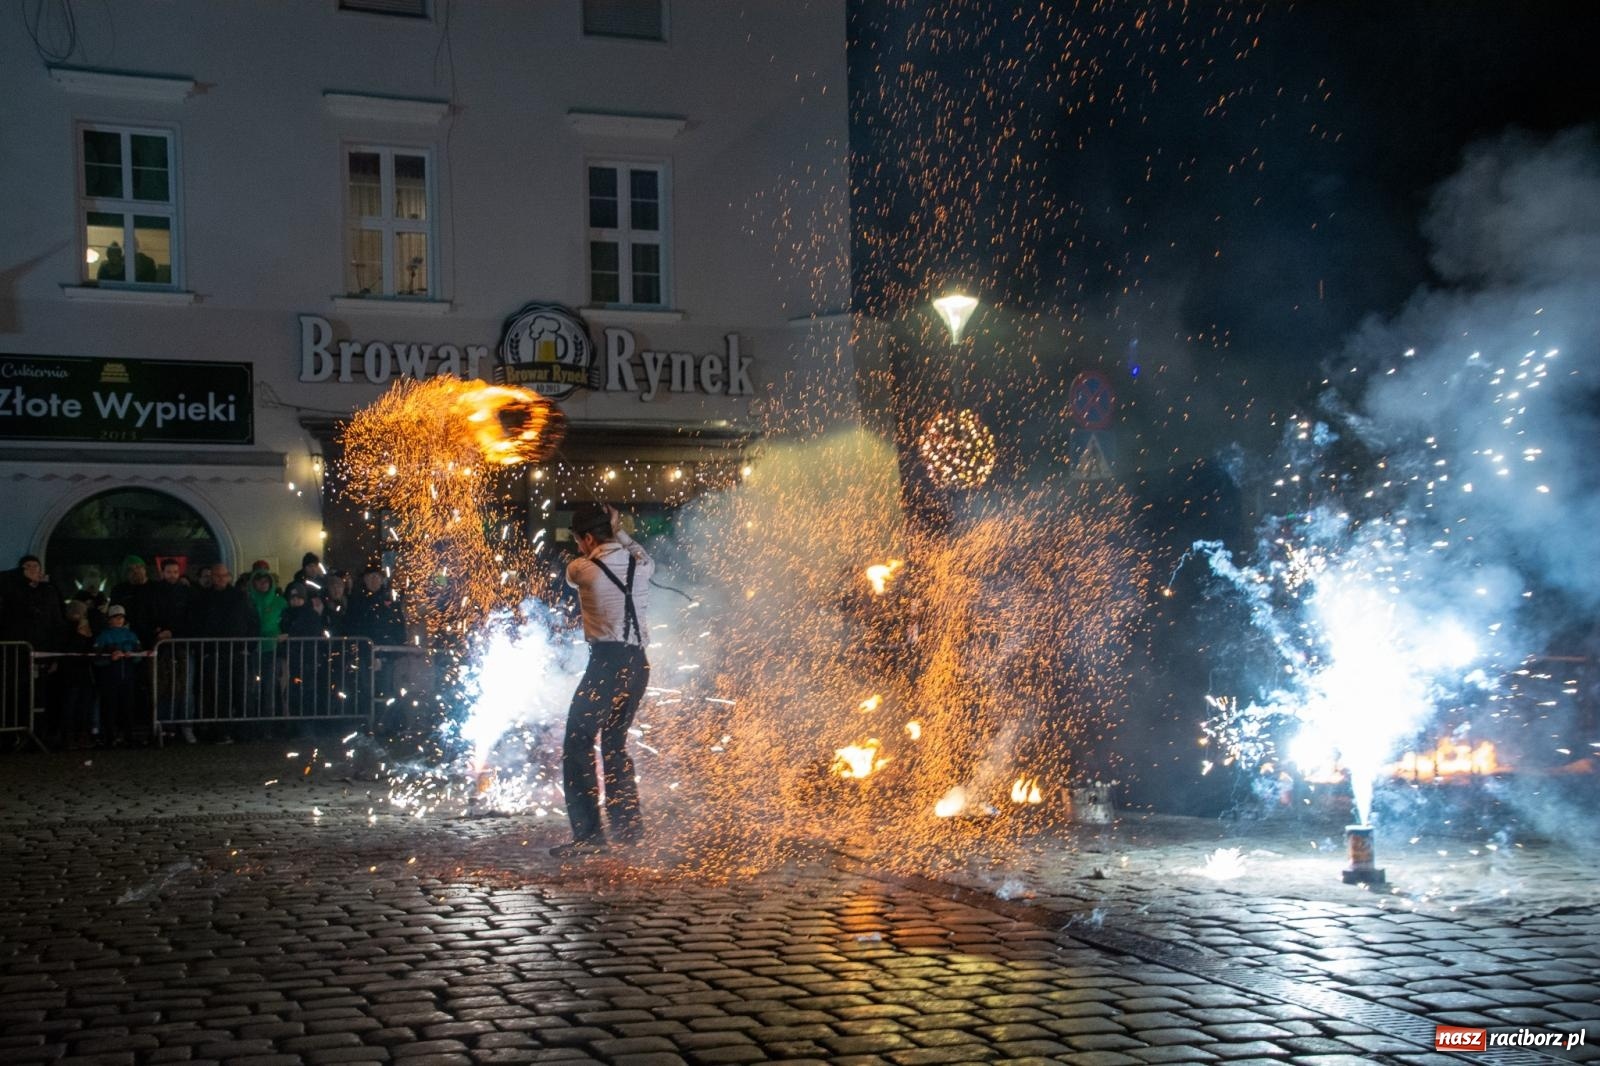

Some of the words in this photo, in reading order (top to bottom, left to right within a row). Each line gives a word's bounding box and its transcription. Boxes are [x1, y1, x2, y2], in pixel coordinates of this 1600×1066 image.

[1, 362, 70, 379] Cukiernia
[299, 315, 488, 385] Browar
[603, 328, 755, 401] Rynek
[506, 365, 549, 382] Browar
[552, 364, 589, 384] Rynek
[0, 386, 82, 418] Złote
[93, 391, 236, 428] Wypieki
